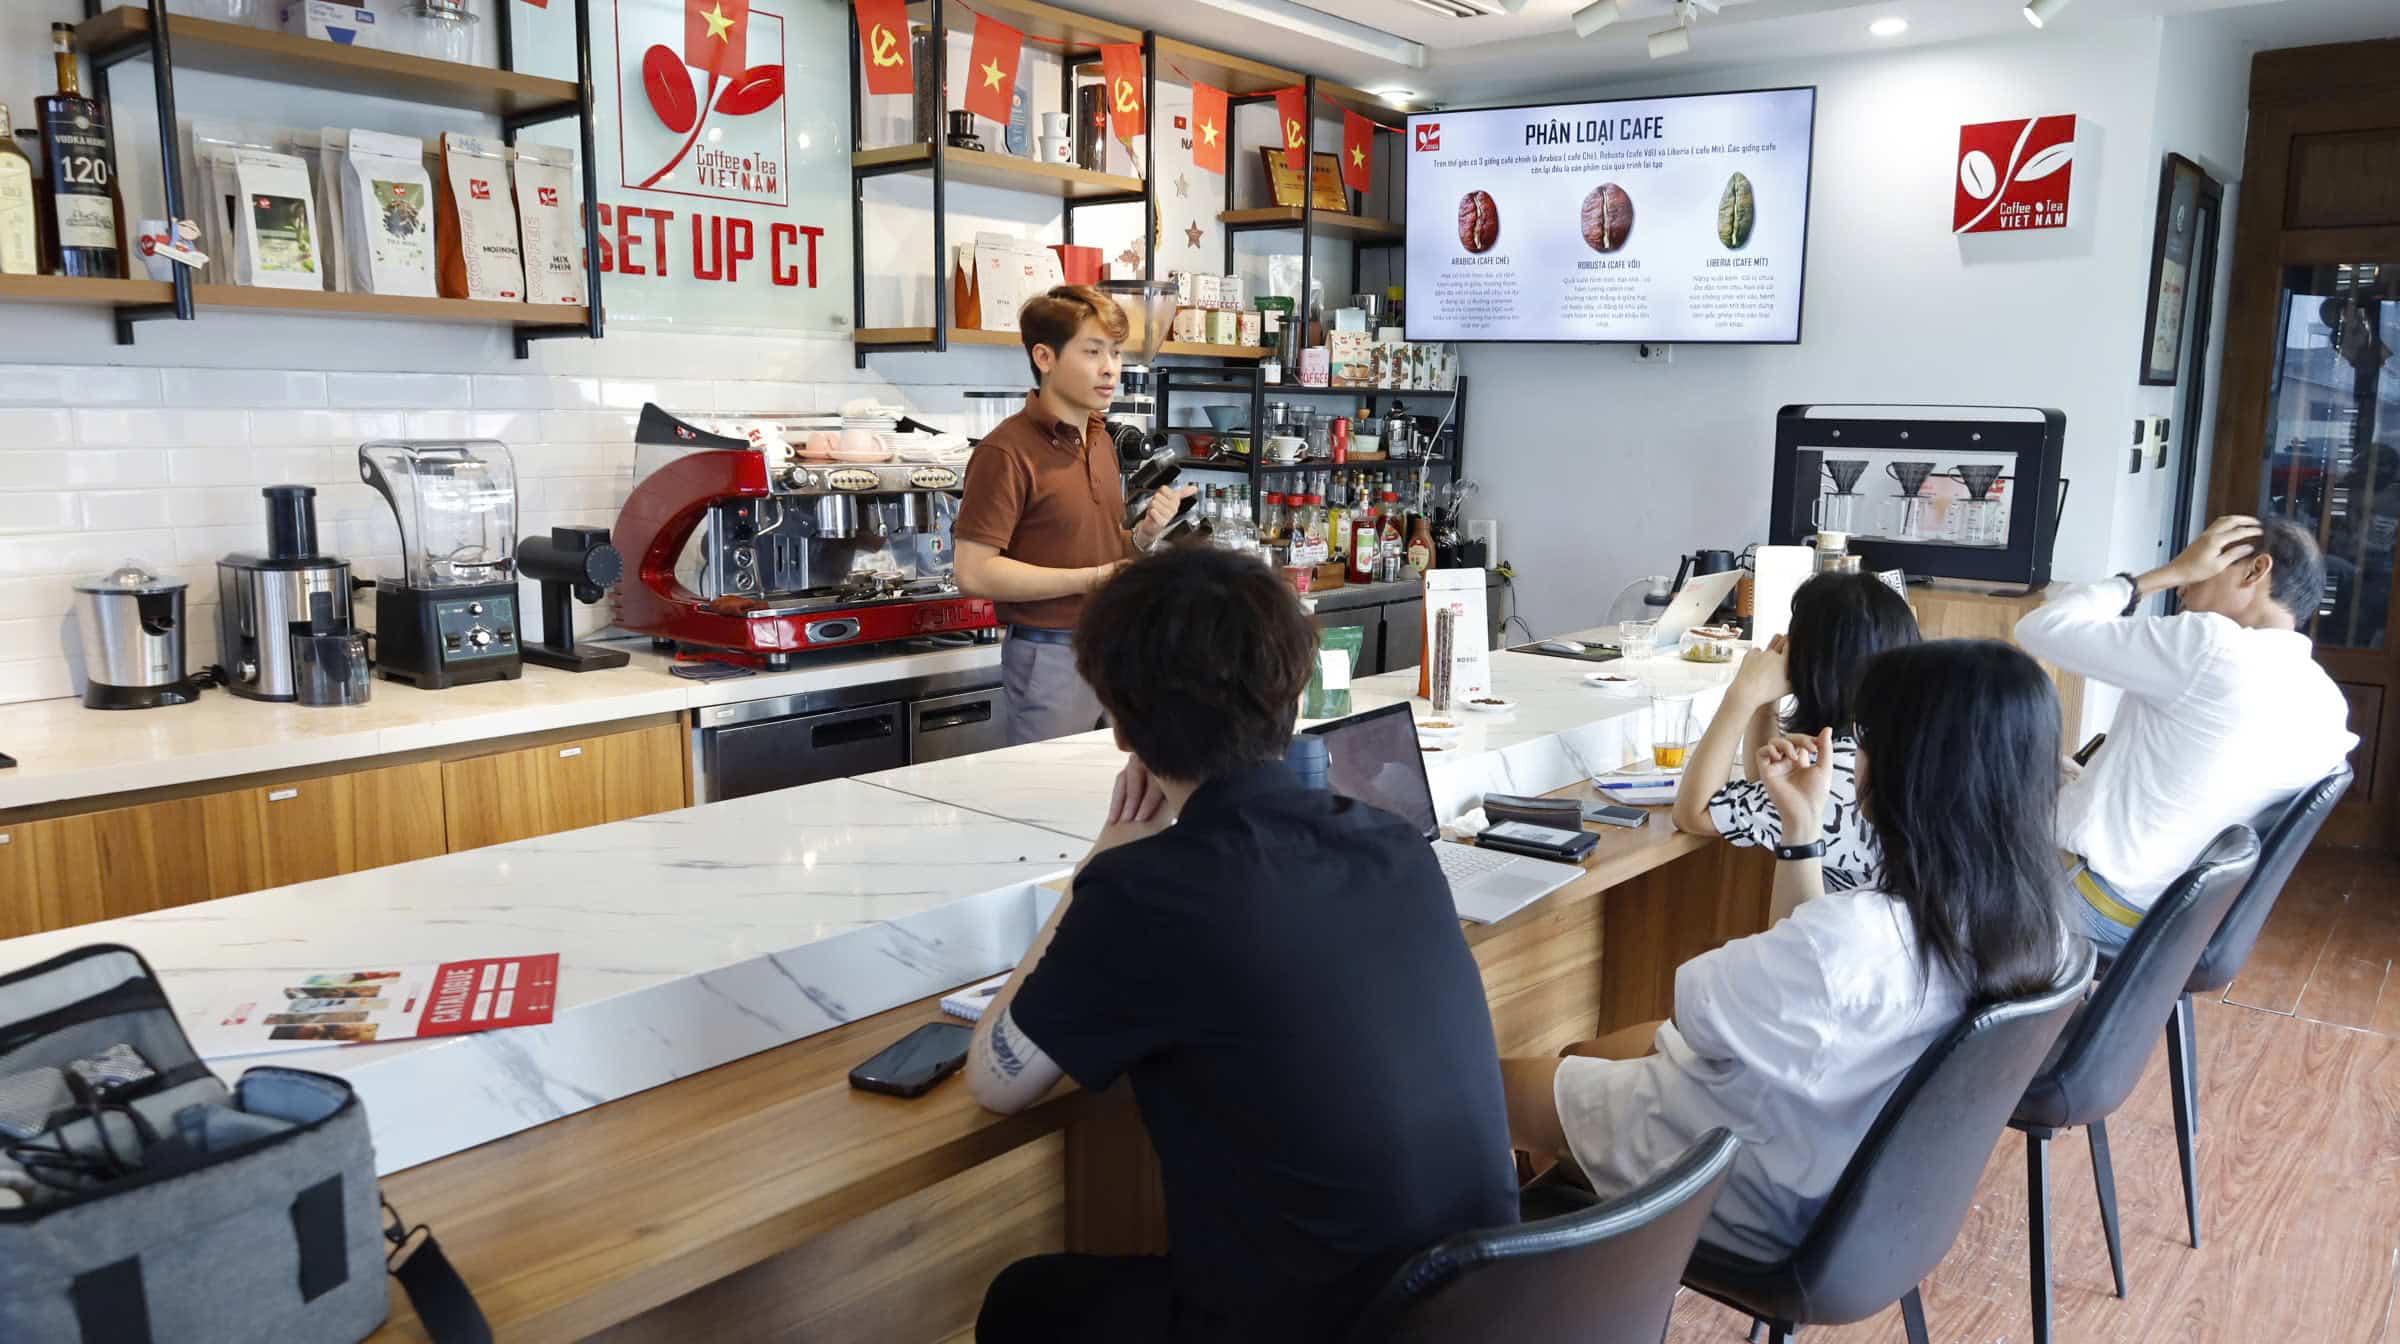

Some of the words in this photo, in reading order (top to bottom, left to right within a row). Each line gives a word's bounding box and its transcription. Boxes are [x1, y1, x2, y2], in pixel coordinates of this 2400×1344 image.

[1525, 118, 1570, 146] PHÂN
[1577, 119, 1614, 146] LOẠI
[1620, 116, 1664, 141] CAFE
[61, 155, 107, 185] 120
[696, 144, 740, 170] Coffee
[754, 152, 777, 175] Tea
[2000, 201, 2031, 215] Coffee
[2046, 199, 2063, 212] Tea
[2000, 214, 2030, 228] VIET
[2035, 212, 2064, 226] NAM
[692, 213, 754, 282] UP
[771, 222, 825, 289] CT
[430, 967, 476, 1024] CATALOGUE
